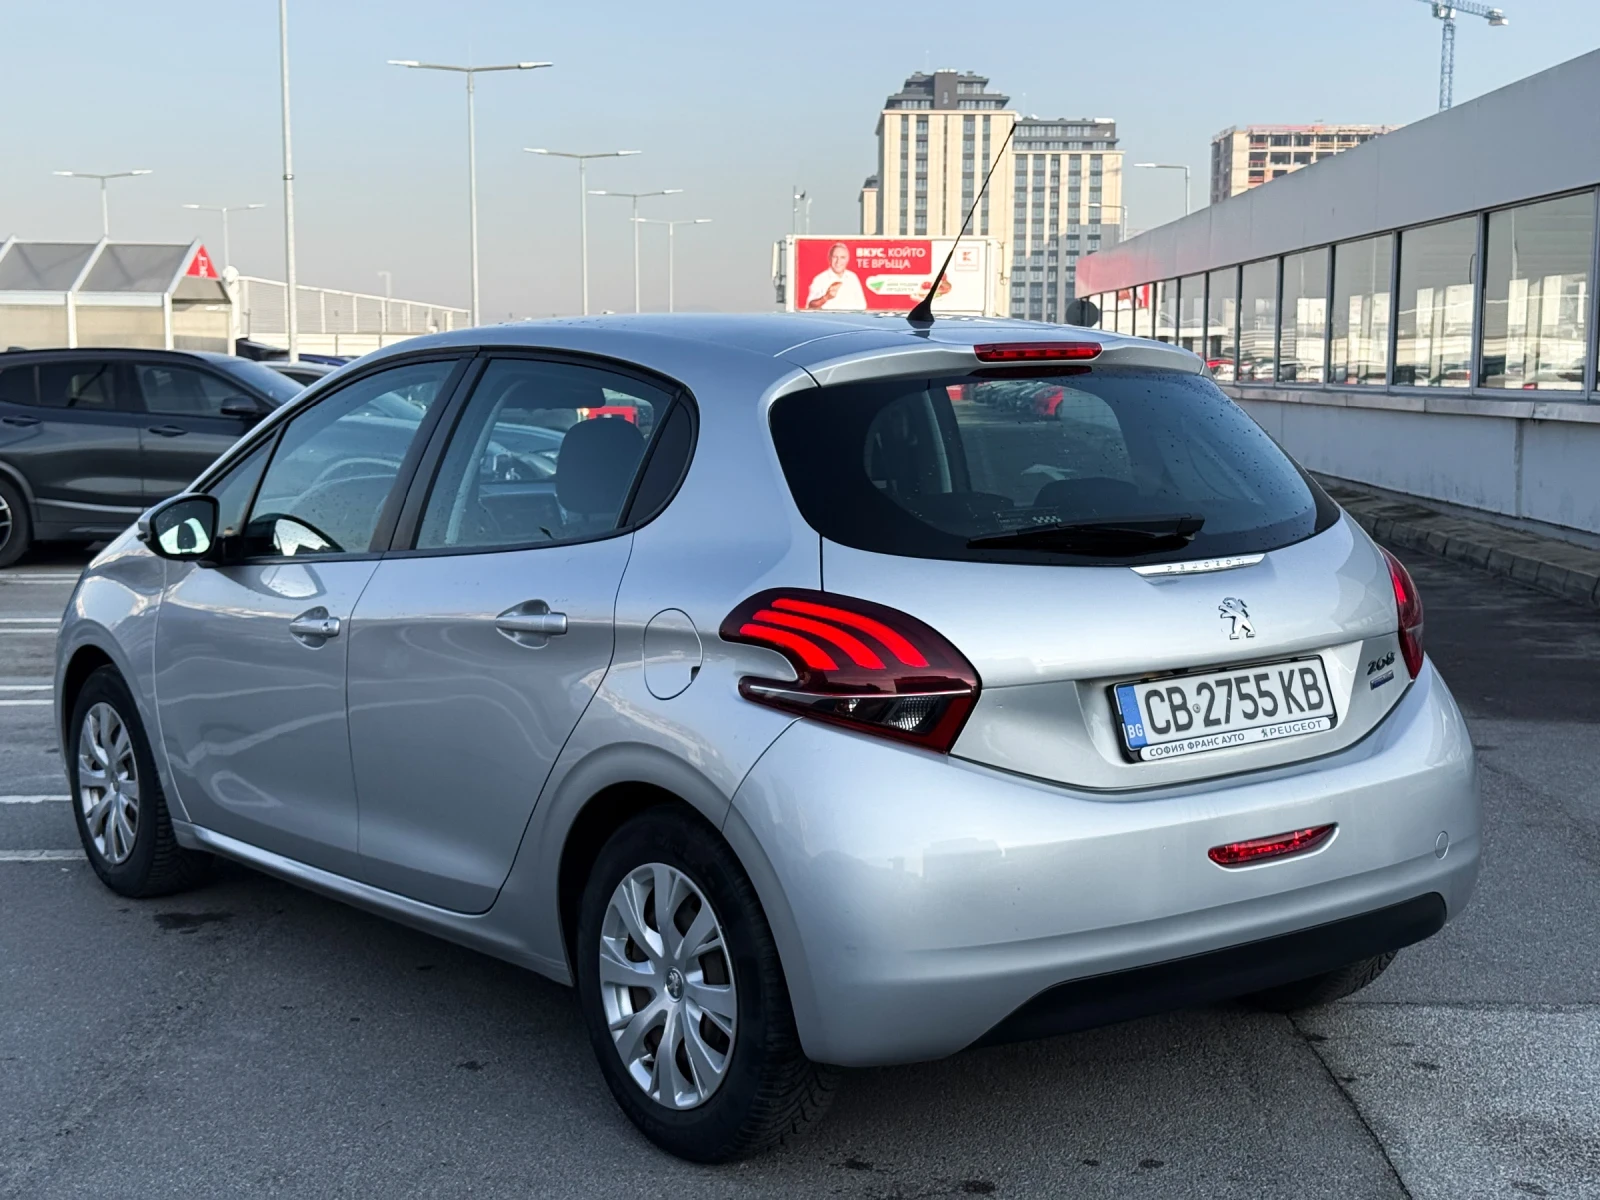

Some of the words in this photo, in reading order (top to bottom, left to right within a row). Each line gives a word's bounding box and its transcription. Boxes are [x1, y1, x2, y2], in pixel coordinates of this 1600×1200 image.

[888, 246, 926, 257] КОЙТО
[856, 259, 869, 268] ТЕ
[871, 259, 911, 270] ВРЪЩА
[1367, 651, 1395, 676] 208
[1196, 673, 1278, 728] 2755
[1127, 724, 1143, 739] BG
[1269, 720, 1323, 737] PEUGEOT
[1149, 743, 1185, 757] СОФИЯ
[1187, 736, 1219, 752] ФРАНС
[1221, 732, 1245, 746] АУТО
